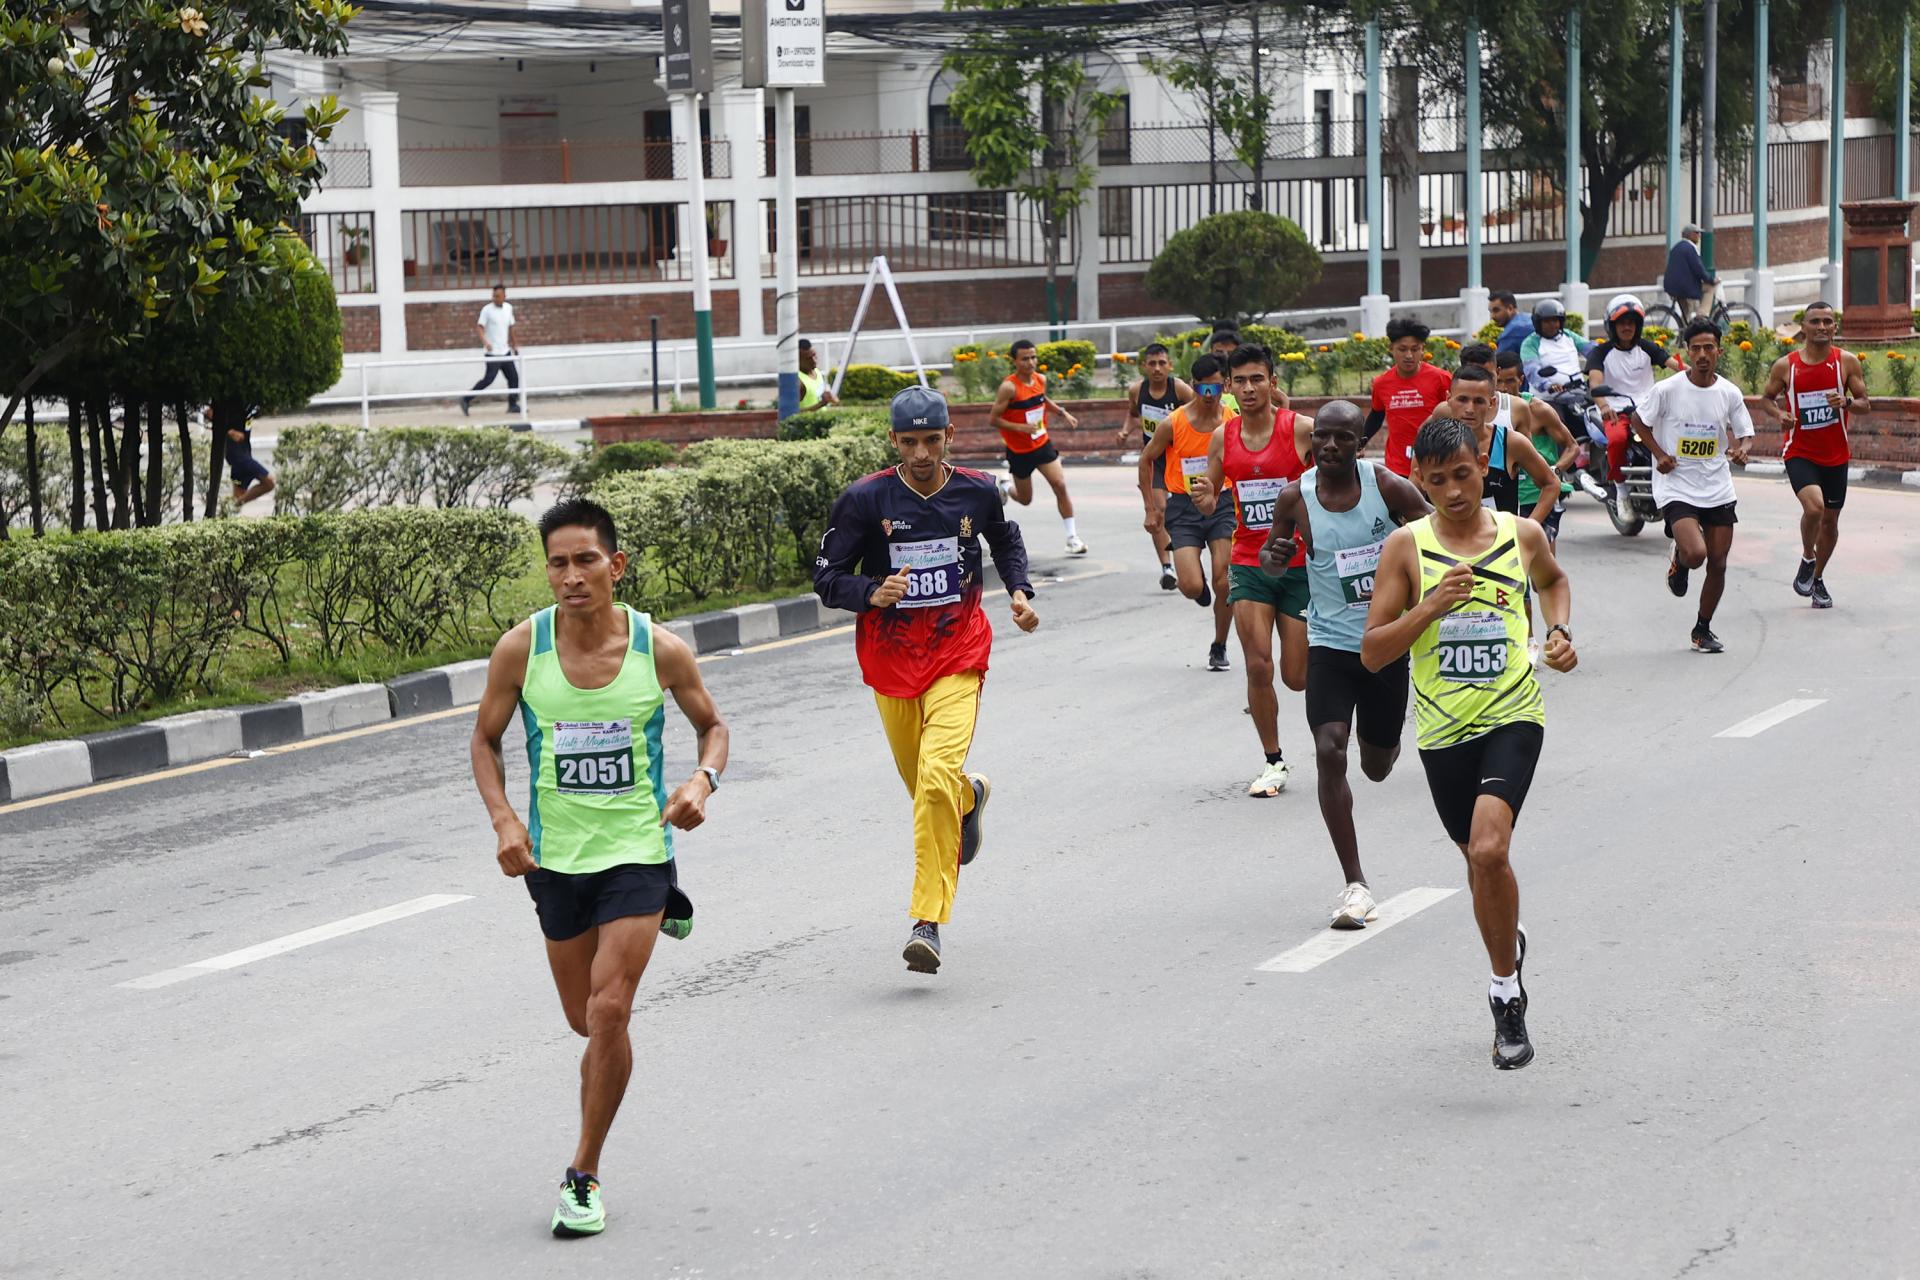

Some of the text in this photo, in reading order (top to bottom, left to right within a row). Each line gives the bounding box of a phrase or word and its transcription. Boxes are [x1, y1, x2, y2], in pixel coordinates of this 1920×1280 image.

[769, 17, 801, 26] AMBITION
[913, 417, 928, 425] NIKE
[1805, 406, 1833, 423] 1742
[1144, 418, 1156, 433] 50
[1681, 440, 1715, 456] 5206
[1245, 503, 1275, 523] 205
[906, 569, 948, 597] 688
[1439, 643, 1507, 673] 2053
[602, 726, 627, 734] KANTIPUR
[560, 753, 630, 785] 2051
